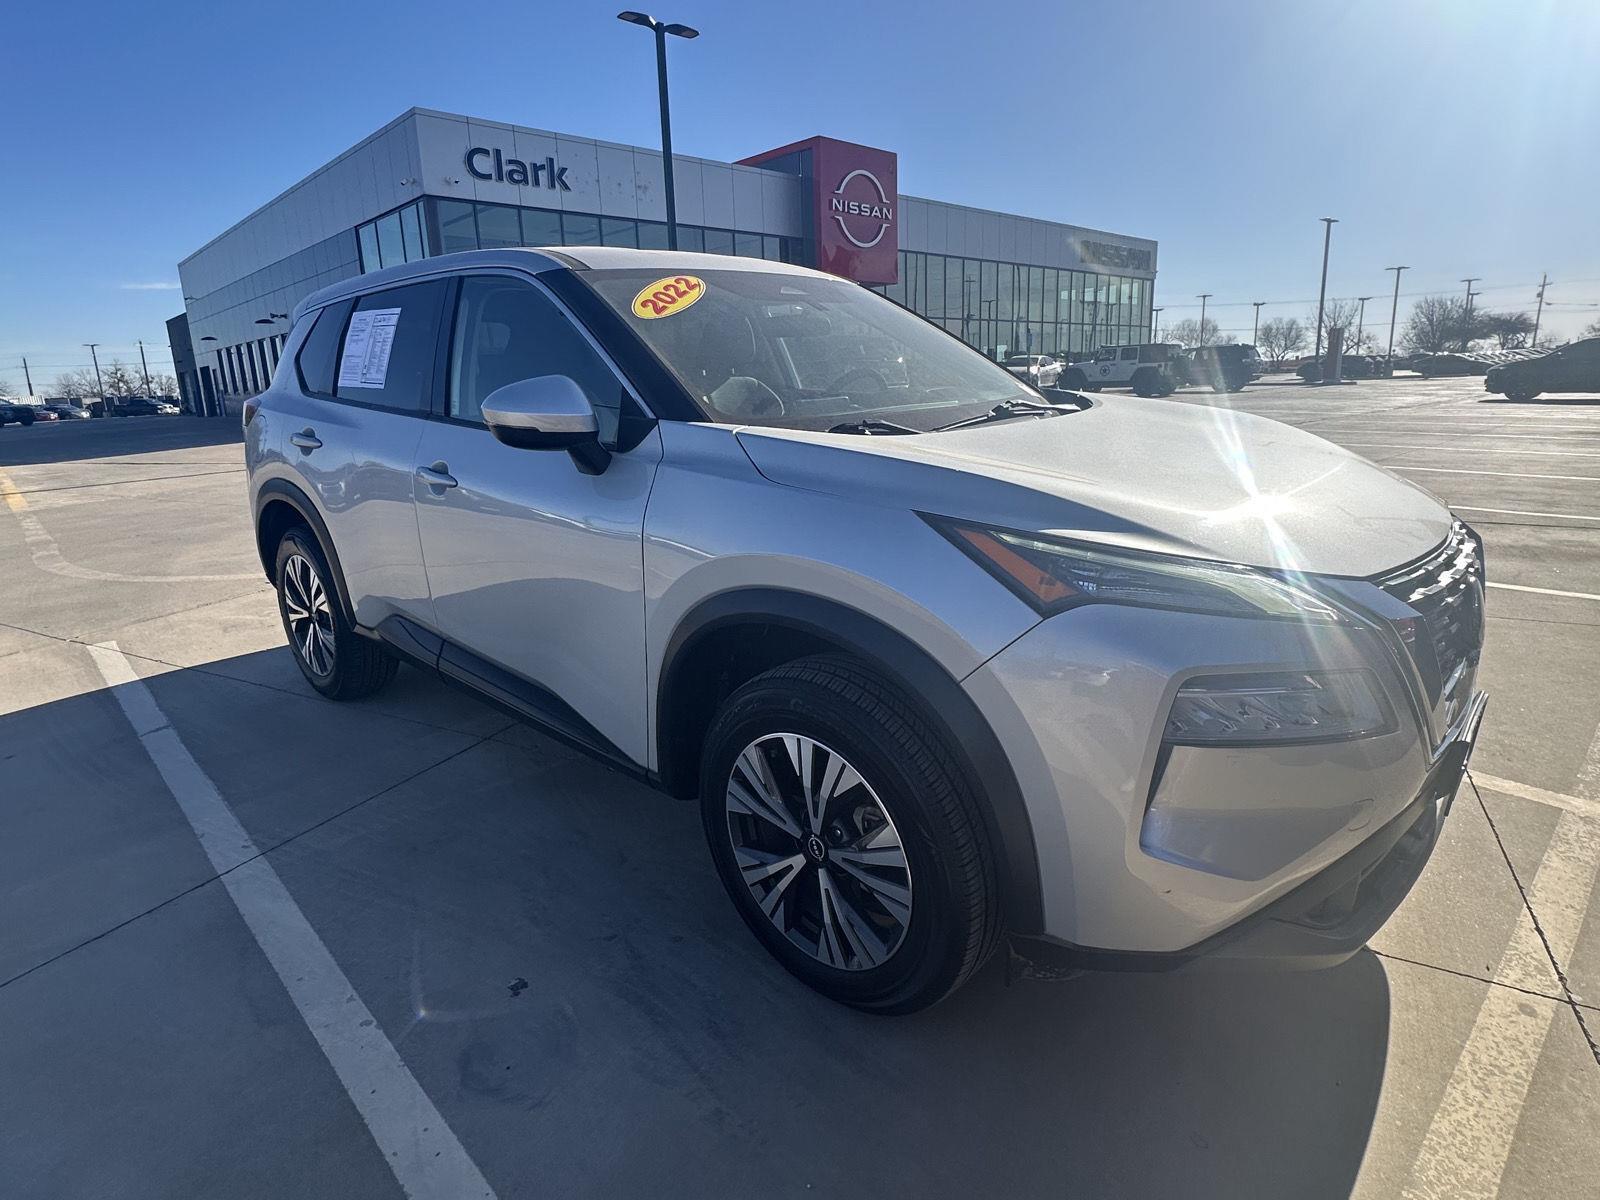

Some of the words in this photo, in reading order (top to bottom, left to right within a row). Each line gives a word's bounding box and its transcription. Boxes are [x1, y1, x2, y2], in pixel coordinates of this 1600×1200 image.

[465, 147, 572, 192] Clark
[832, 198, 892, 220] NISSAN
[640, 277, 699, 315] 2022
